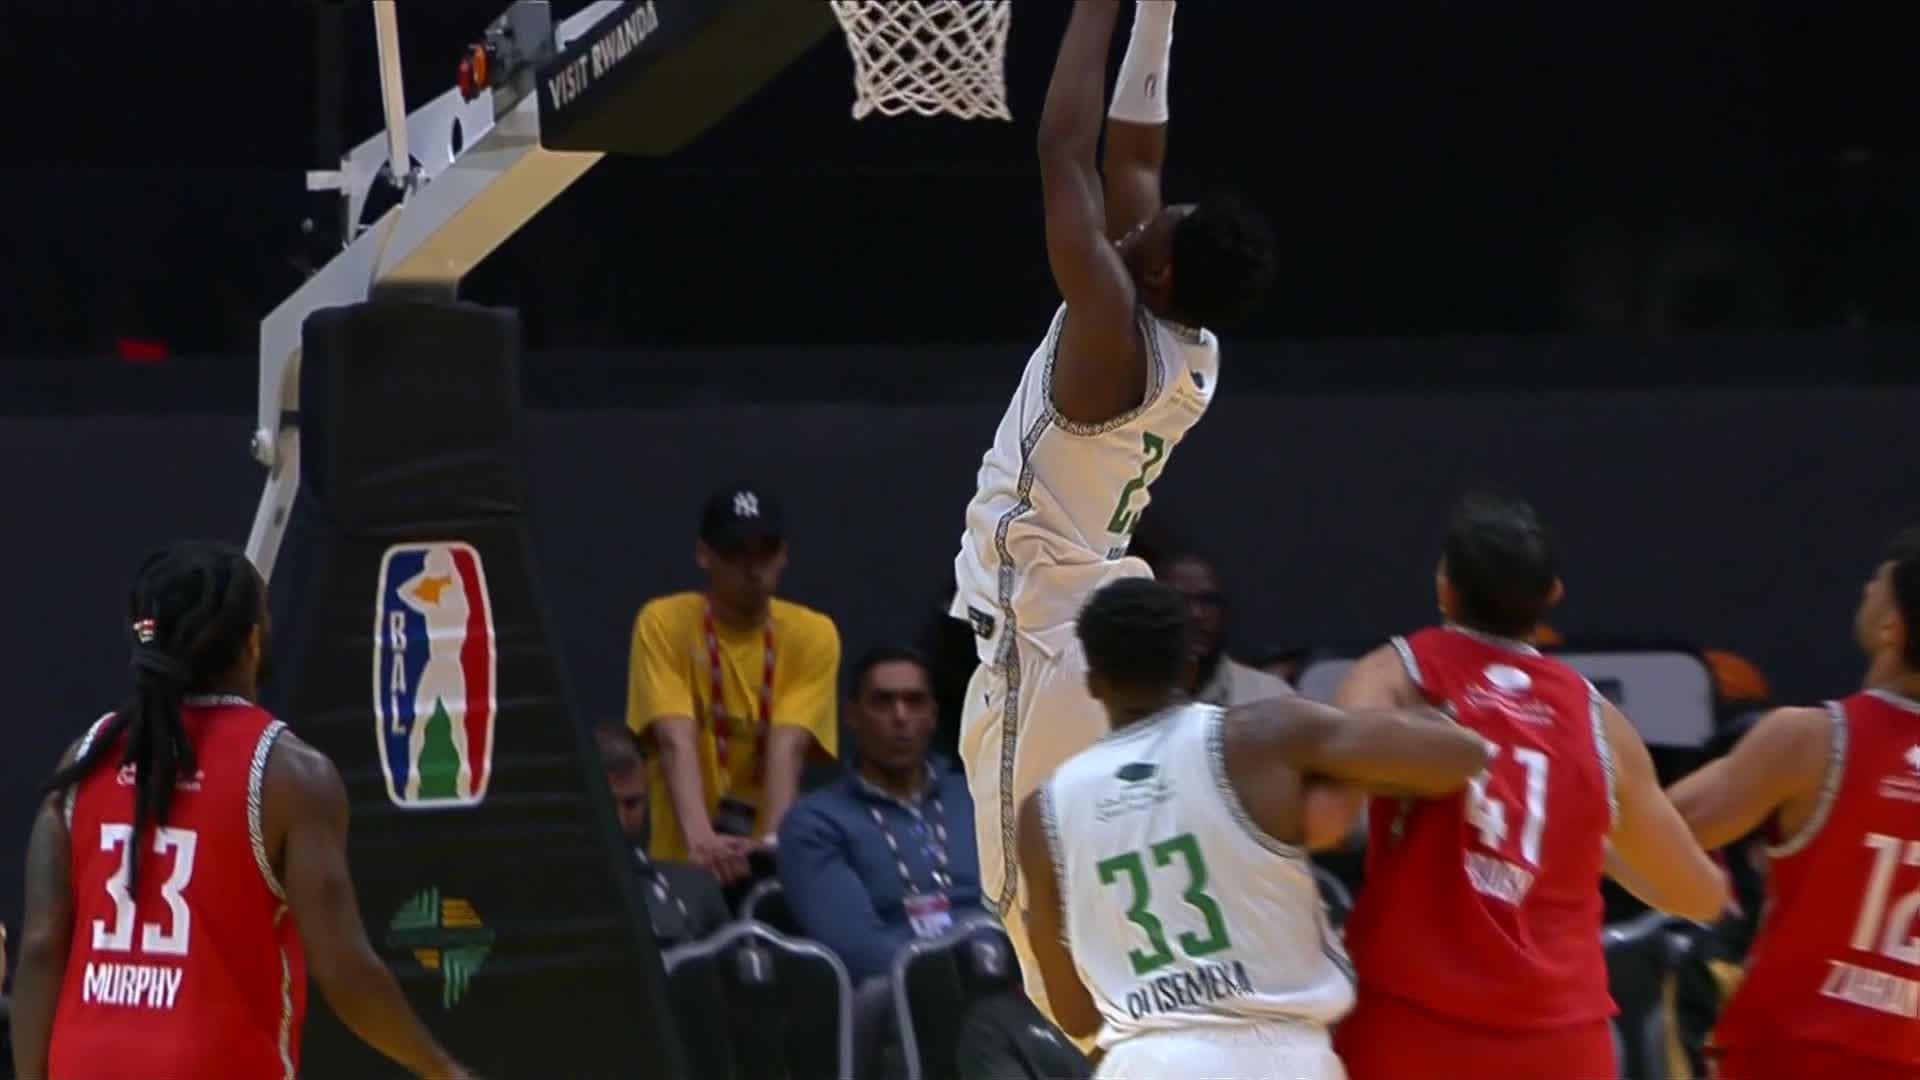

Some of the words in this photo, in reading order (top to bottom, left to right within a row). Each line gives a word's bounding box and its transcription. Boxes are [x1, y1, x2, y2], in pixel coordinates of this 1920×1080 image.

[548, 54, 589, 111] VISIT
[591, 0, 659, 80] RWANDA
[1107, 431, 1165, 534] 2
[389, 611, 408, 736] BAL
[93, 823, 198, 955] 33
[1097, 832, 1231, 975] 33
[84, 963, 182, 1008] MURPHY
